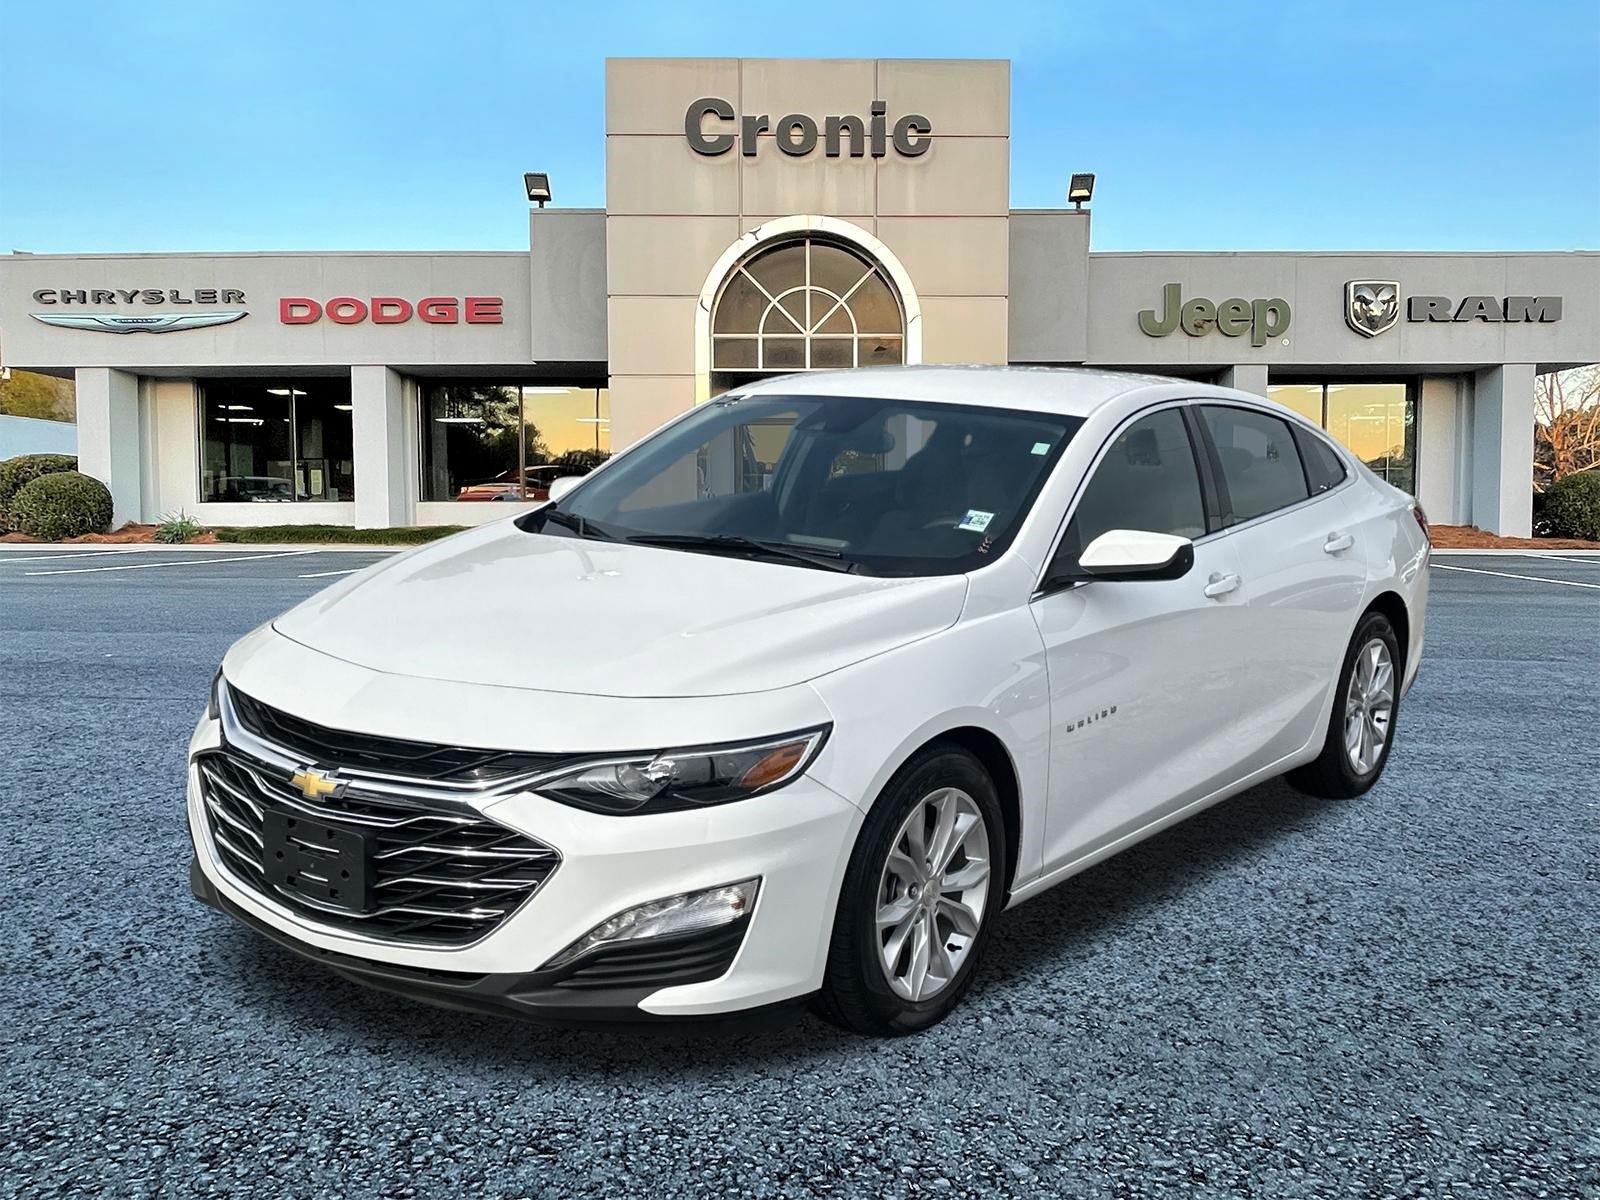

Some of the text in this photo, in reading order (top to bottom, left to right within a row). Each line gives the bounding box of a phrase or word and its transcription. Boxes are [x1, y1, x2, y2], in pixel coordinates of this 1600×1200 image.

[685, 97, 932, 157] Cronic
[33, 289, 246, 304] CHRYSLER
[1408, 296, 1563, 322] RAM
[280, 297, 504, 325] DODGE
[1138, 283, 1291, 347] Jeep
